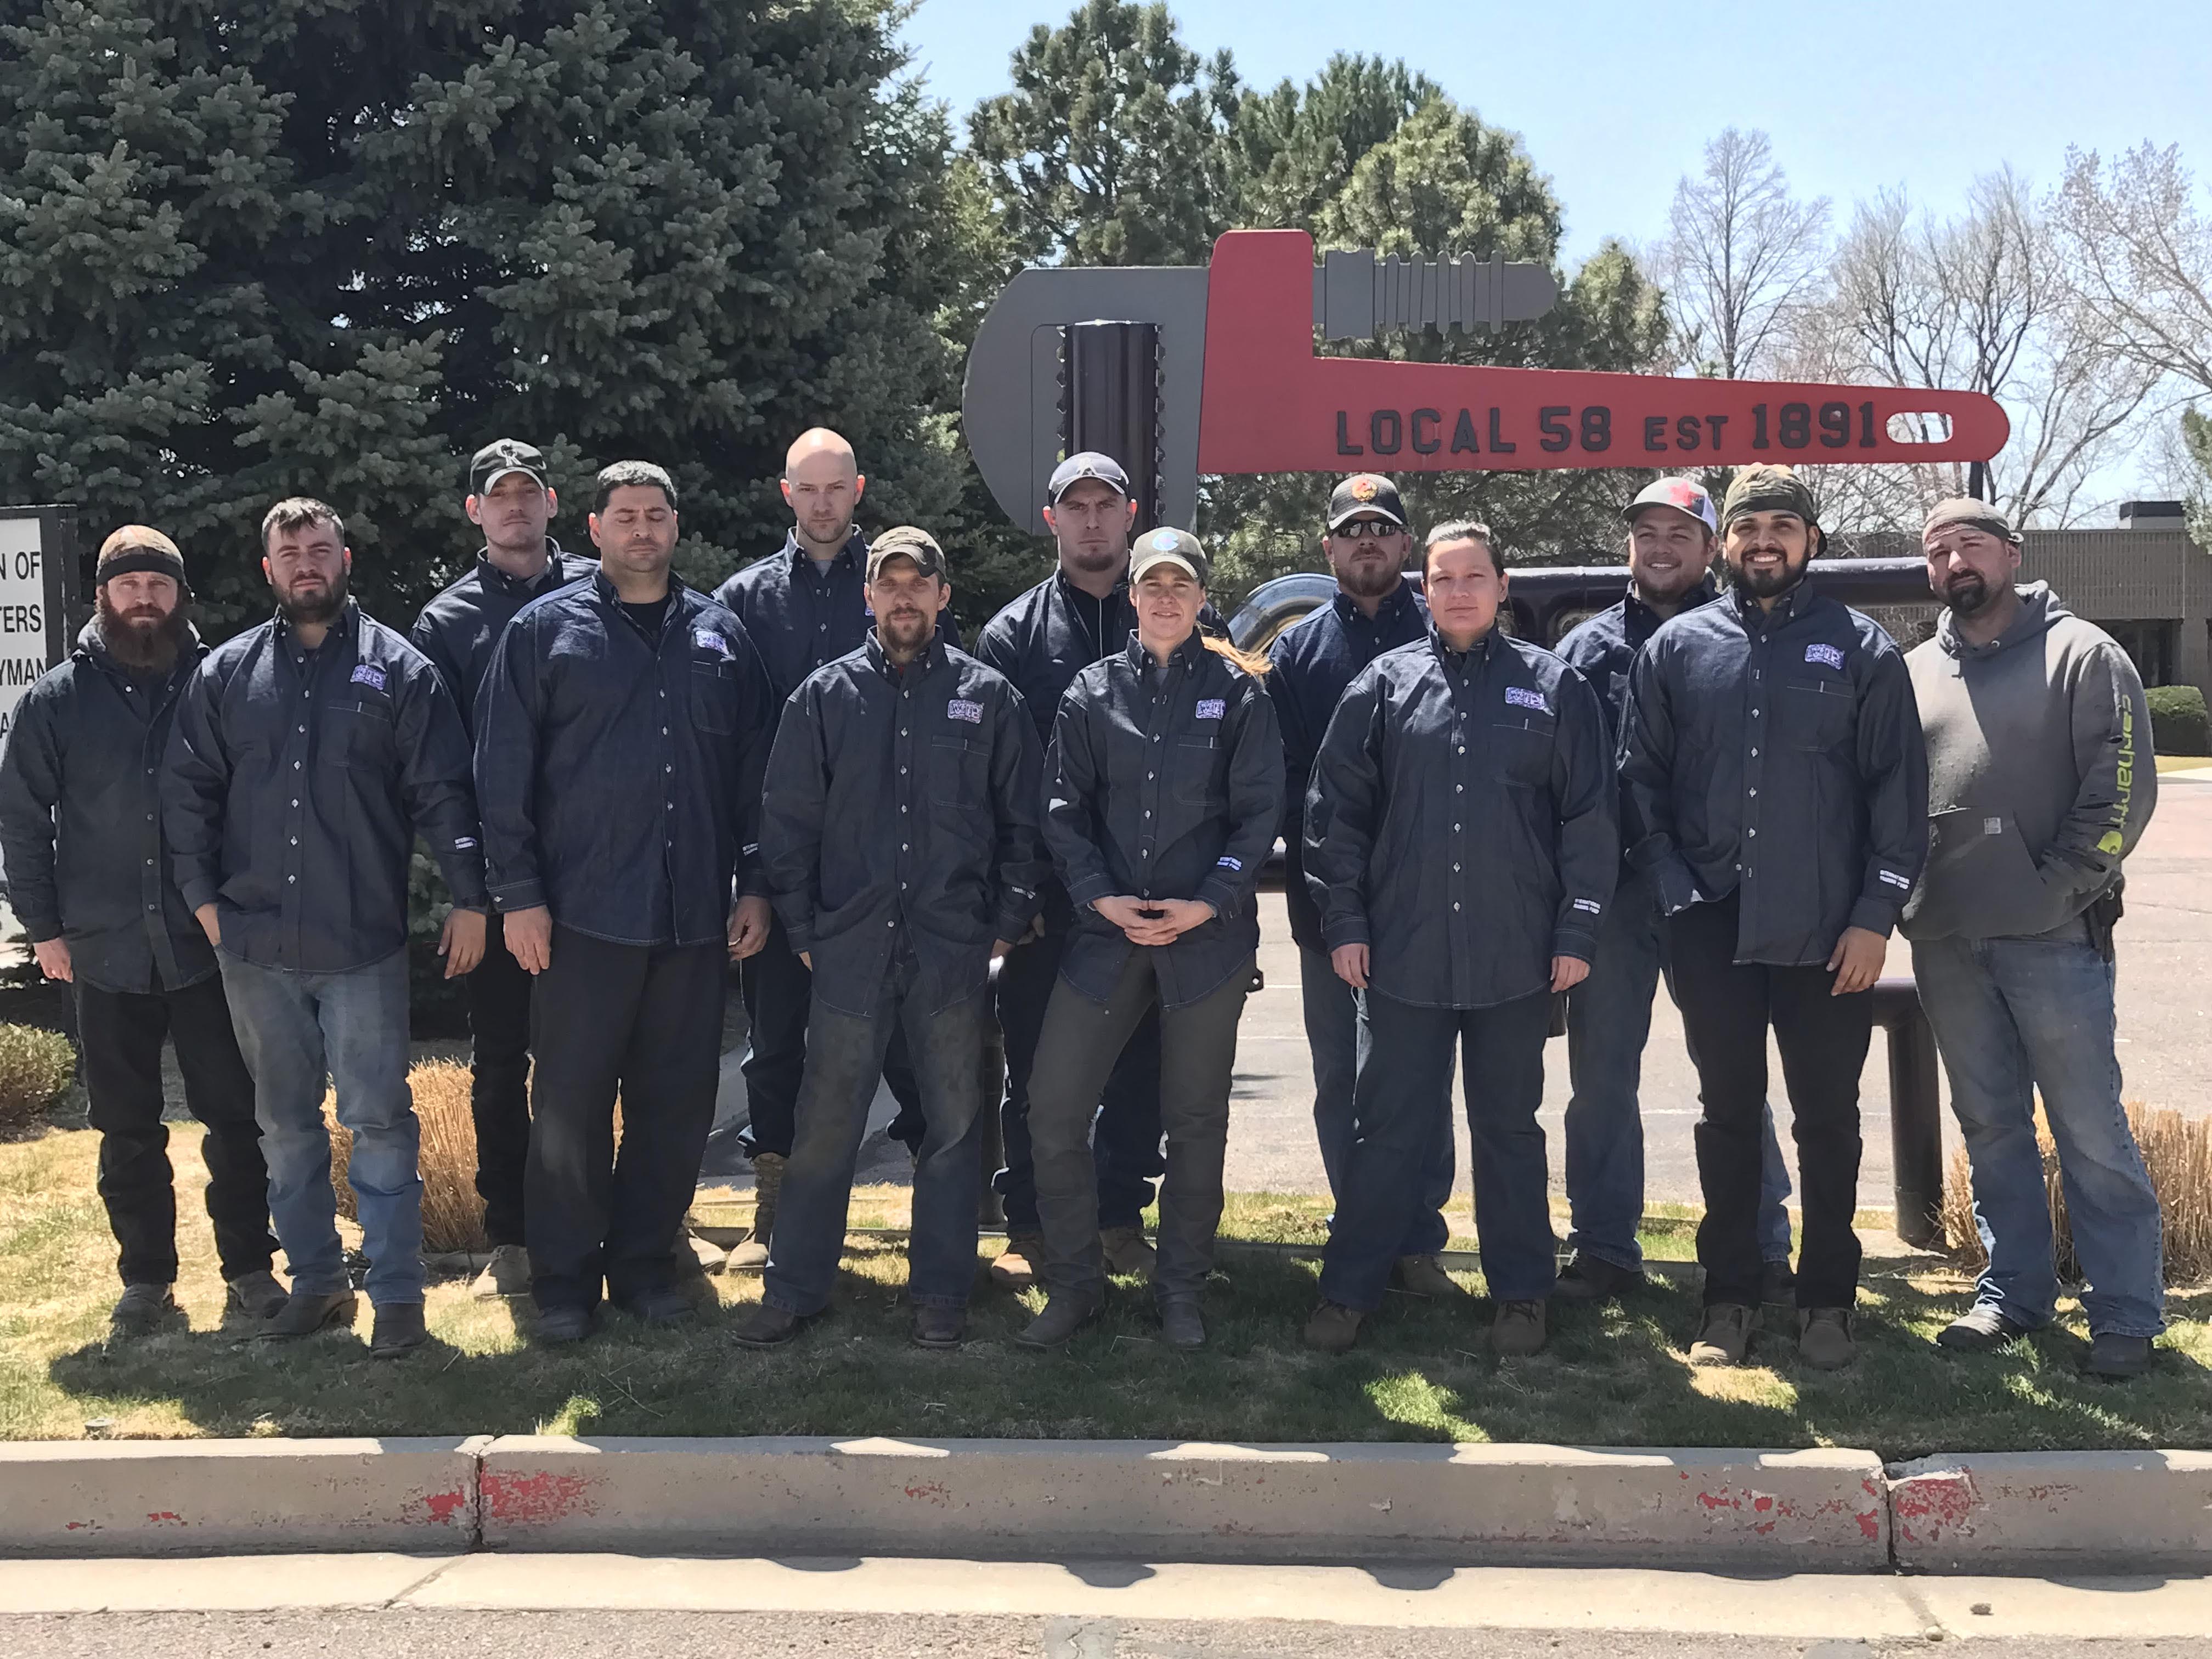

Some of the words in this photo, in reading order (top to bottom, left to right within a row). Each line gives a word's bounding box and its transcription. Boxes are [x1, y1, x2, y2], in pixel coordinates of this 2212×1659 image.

[1337, 407, 1516, 455] LOCAL
[1540, 406, 1611, 452] 58
[1645, 415, 1728, 450] EST
[1752, 401, 1877, 449] 1891
[15, 551, 41, 580] OF
[0, 603, 41, 633] ERS
[2110, 694, 2136, 828] carhartt
